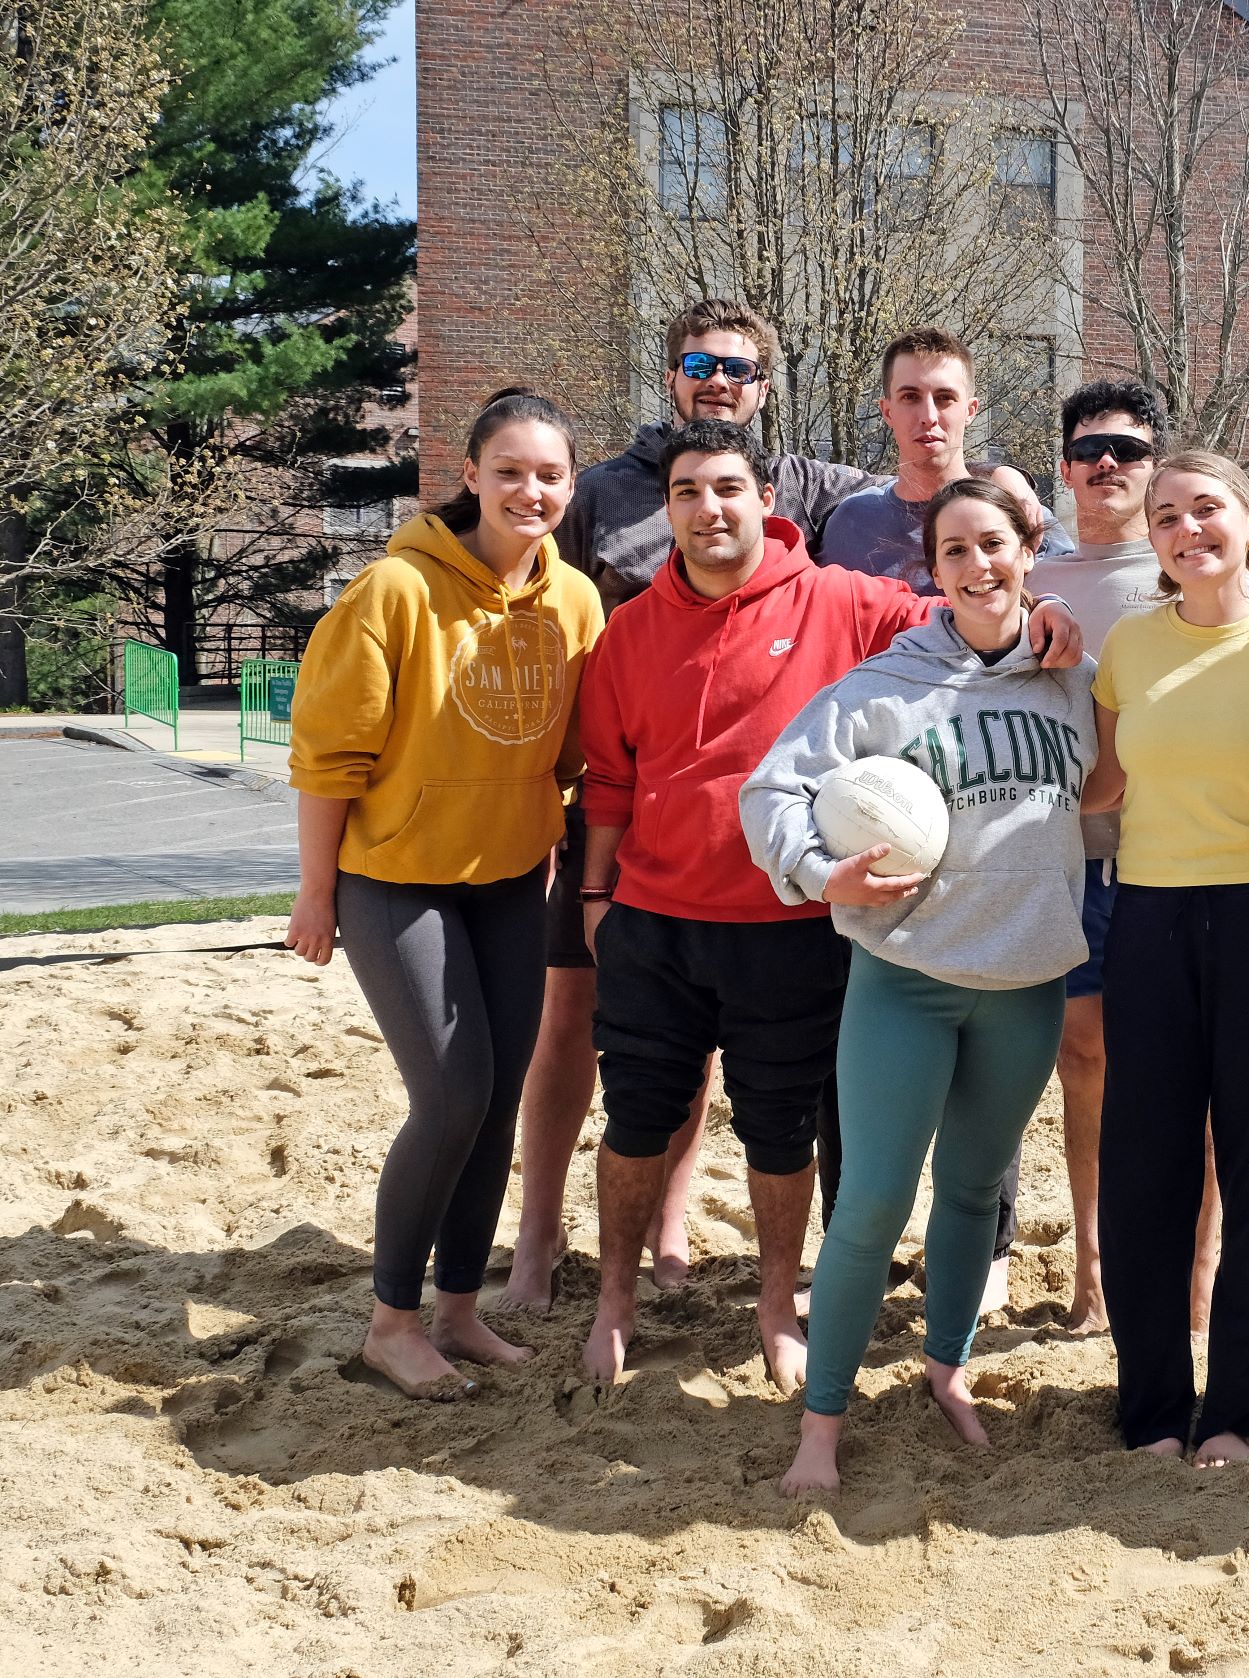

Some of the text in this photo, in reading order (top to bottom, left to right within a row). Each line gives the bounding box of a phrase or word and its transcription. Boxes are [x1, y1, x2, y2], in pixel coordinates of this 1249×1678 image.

[773, 637, 792, 650] NIKE
[465, 661, 502, 690] SAN
[855, 770, 913, 815] Wilson
